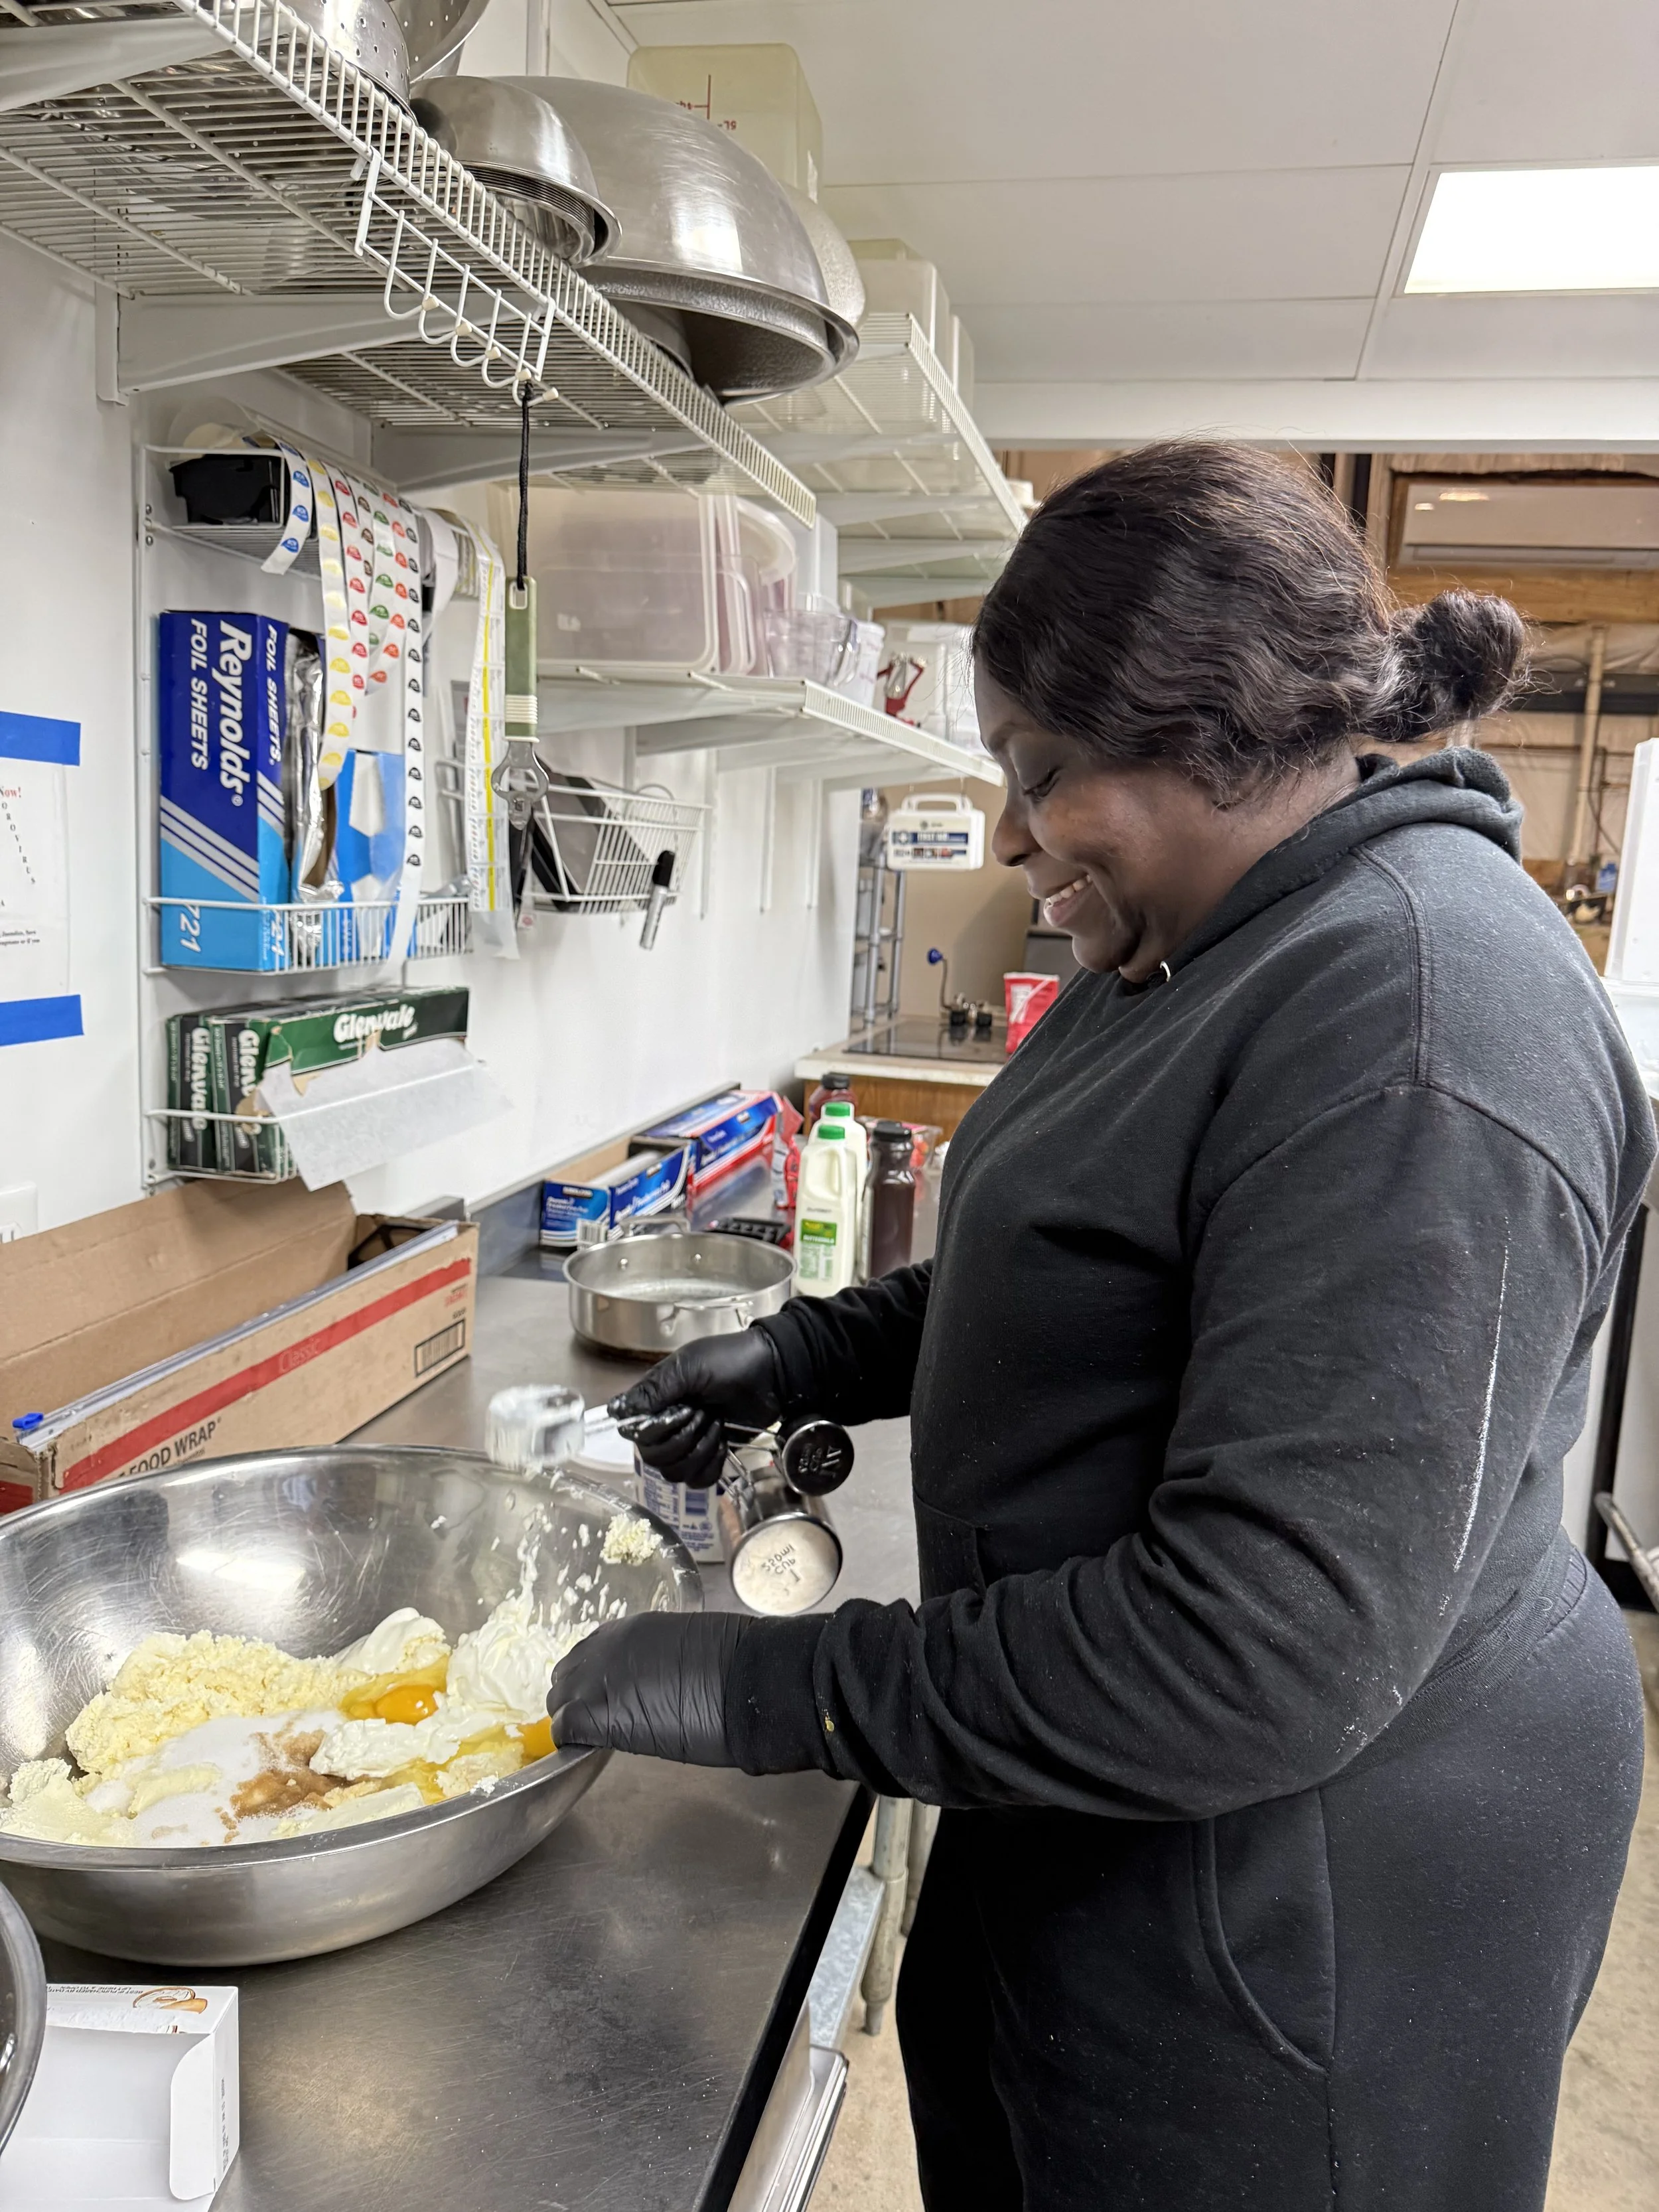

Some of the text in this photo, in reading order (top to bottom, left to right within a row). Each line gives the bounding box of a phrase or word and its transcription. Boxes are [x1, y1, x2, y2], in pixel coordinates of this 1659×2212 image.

[190, 618, 208, 771] FOIL SHEETS
[211, 619, 253, 795] Reynolds
[266, 624, 281, 763] FOIL SHEETS
[190, 1027, 211, 1130] Glenvae
[333, 1003, 416, 1043] Glenvale
[173, 1421, 217, 1457] WRAP
